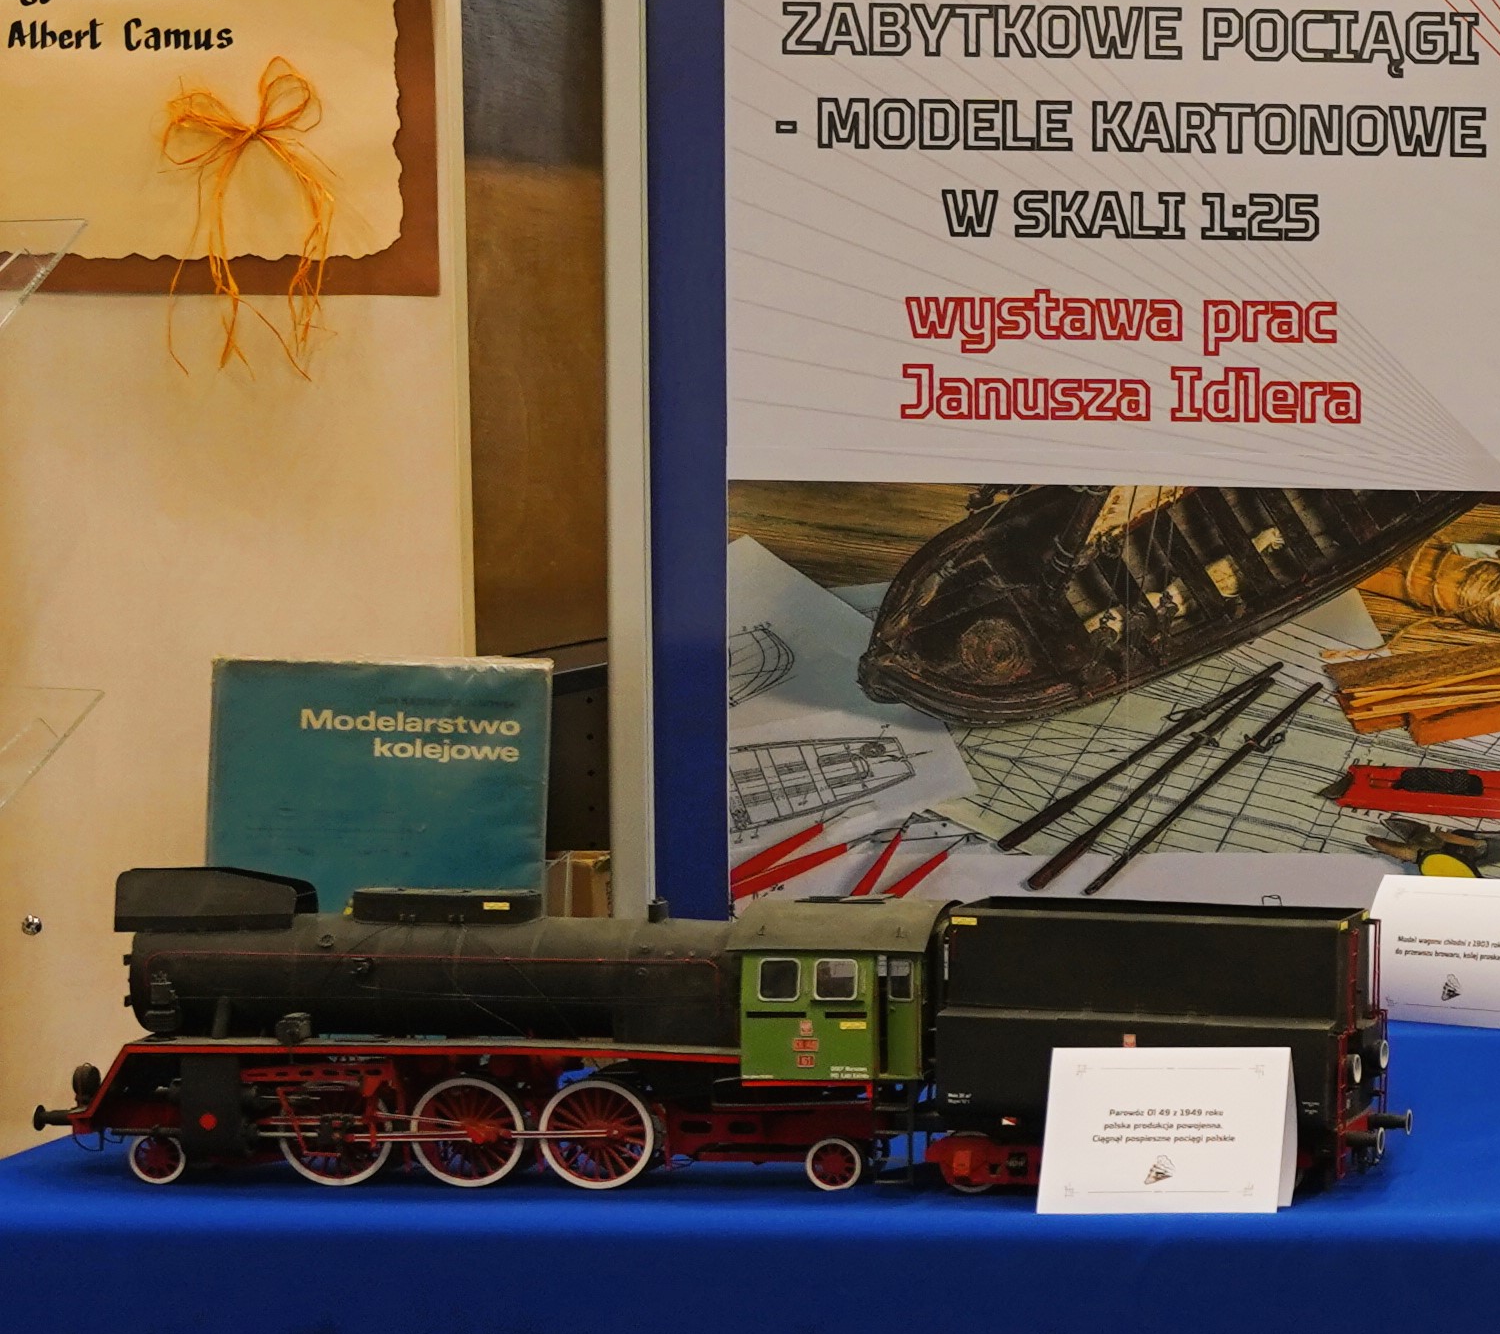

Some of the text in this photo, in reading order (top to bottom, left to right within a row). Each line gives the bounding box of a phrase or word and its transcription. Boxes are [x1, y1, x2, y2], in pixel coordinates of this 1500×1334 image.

[7, 17, 234, 52] Albert Camus
[781, 1, 1480, 79] ZABYTKOWE POCIĄGI
[817, 98, 1073, 151] MODELE
[1091, 101, 1488, 158] KARTONOWE
[941, 188, 1320, 243] W SKALI 1:25
[904, 288, 1338, 356] wystawa prac
[900, 362, 1363, 425] Janusza Idlera
[300, 708, 522, 736] Modelarstwo
[372, 737, 521, 763] kolejowe
